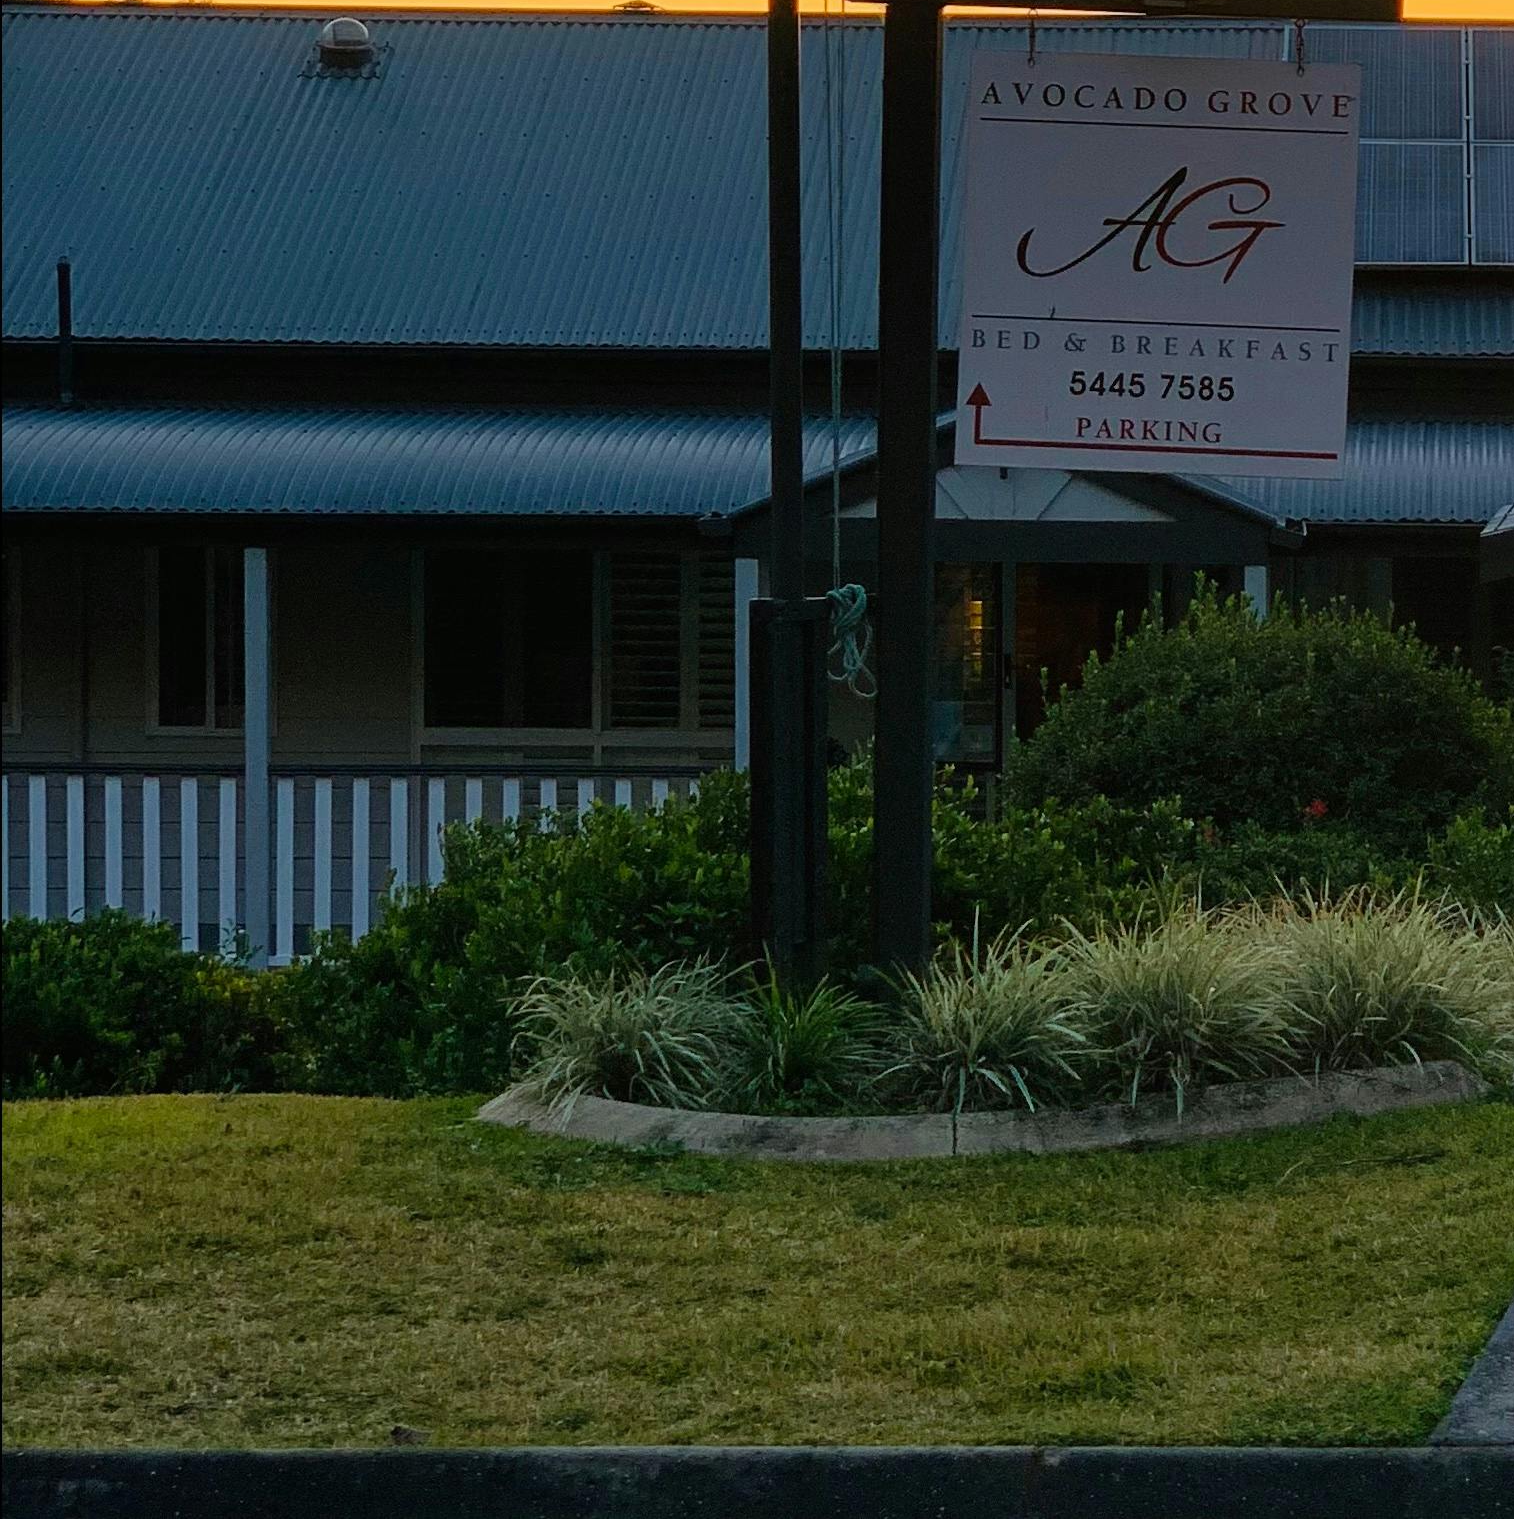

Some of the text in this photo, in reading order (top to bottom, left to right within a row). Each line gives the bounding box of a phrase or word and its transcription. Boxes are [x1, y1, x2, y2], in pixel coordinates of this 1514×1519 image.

[981, 81, 1352, 118] AVOCADO GROVE
[1016, 166, 1286, 284] AG
[971, 328, 1340, 363] BED & BREAKFAST
[1069, 370, 1235, 402] 5445 7585
[1075, 416, 1223, 444] PARKING
